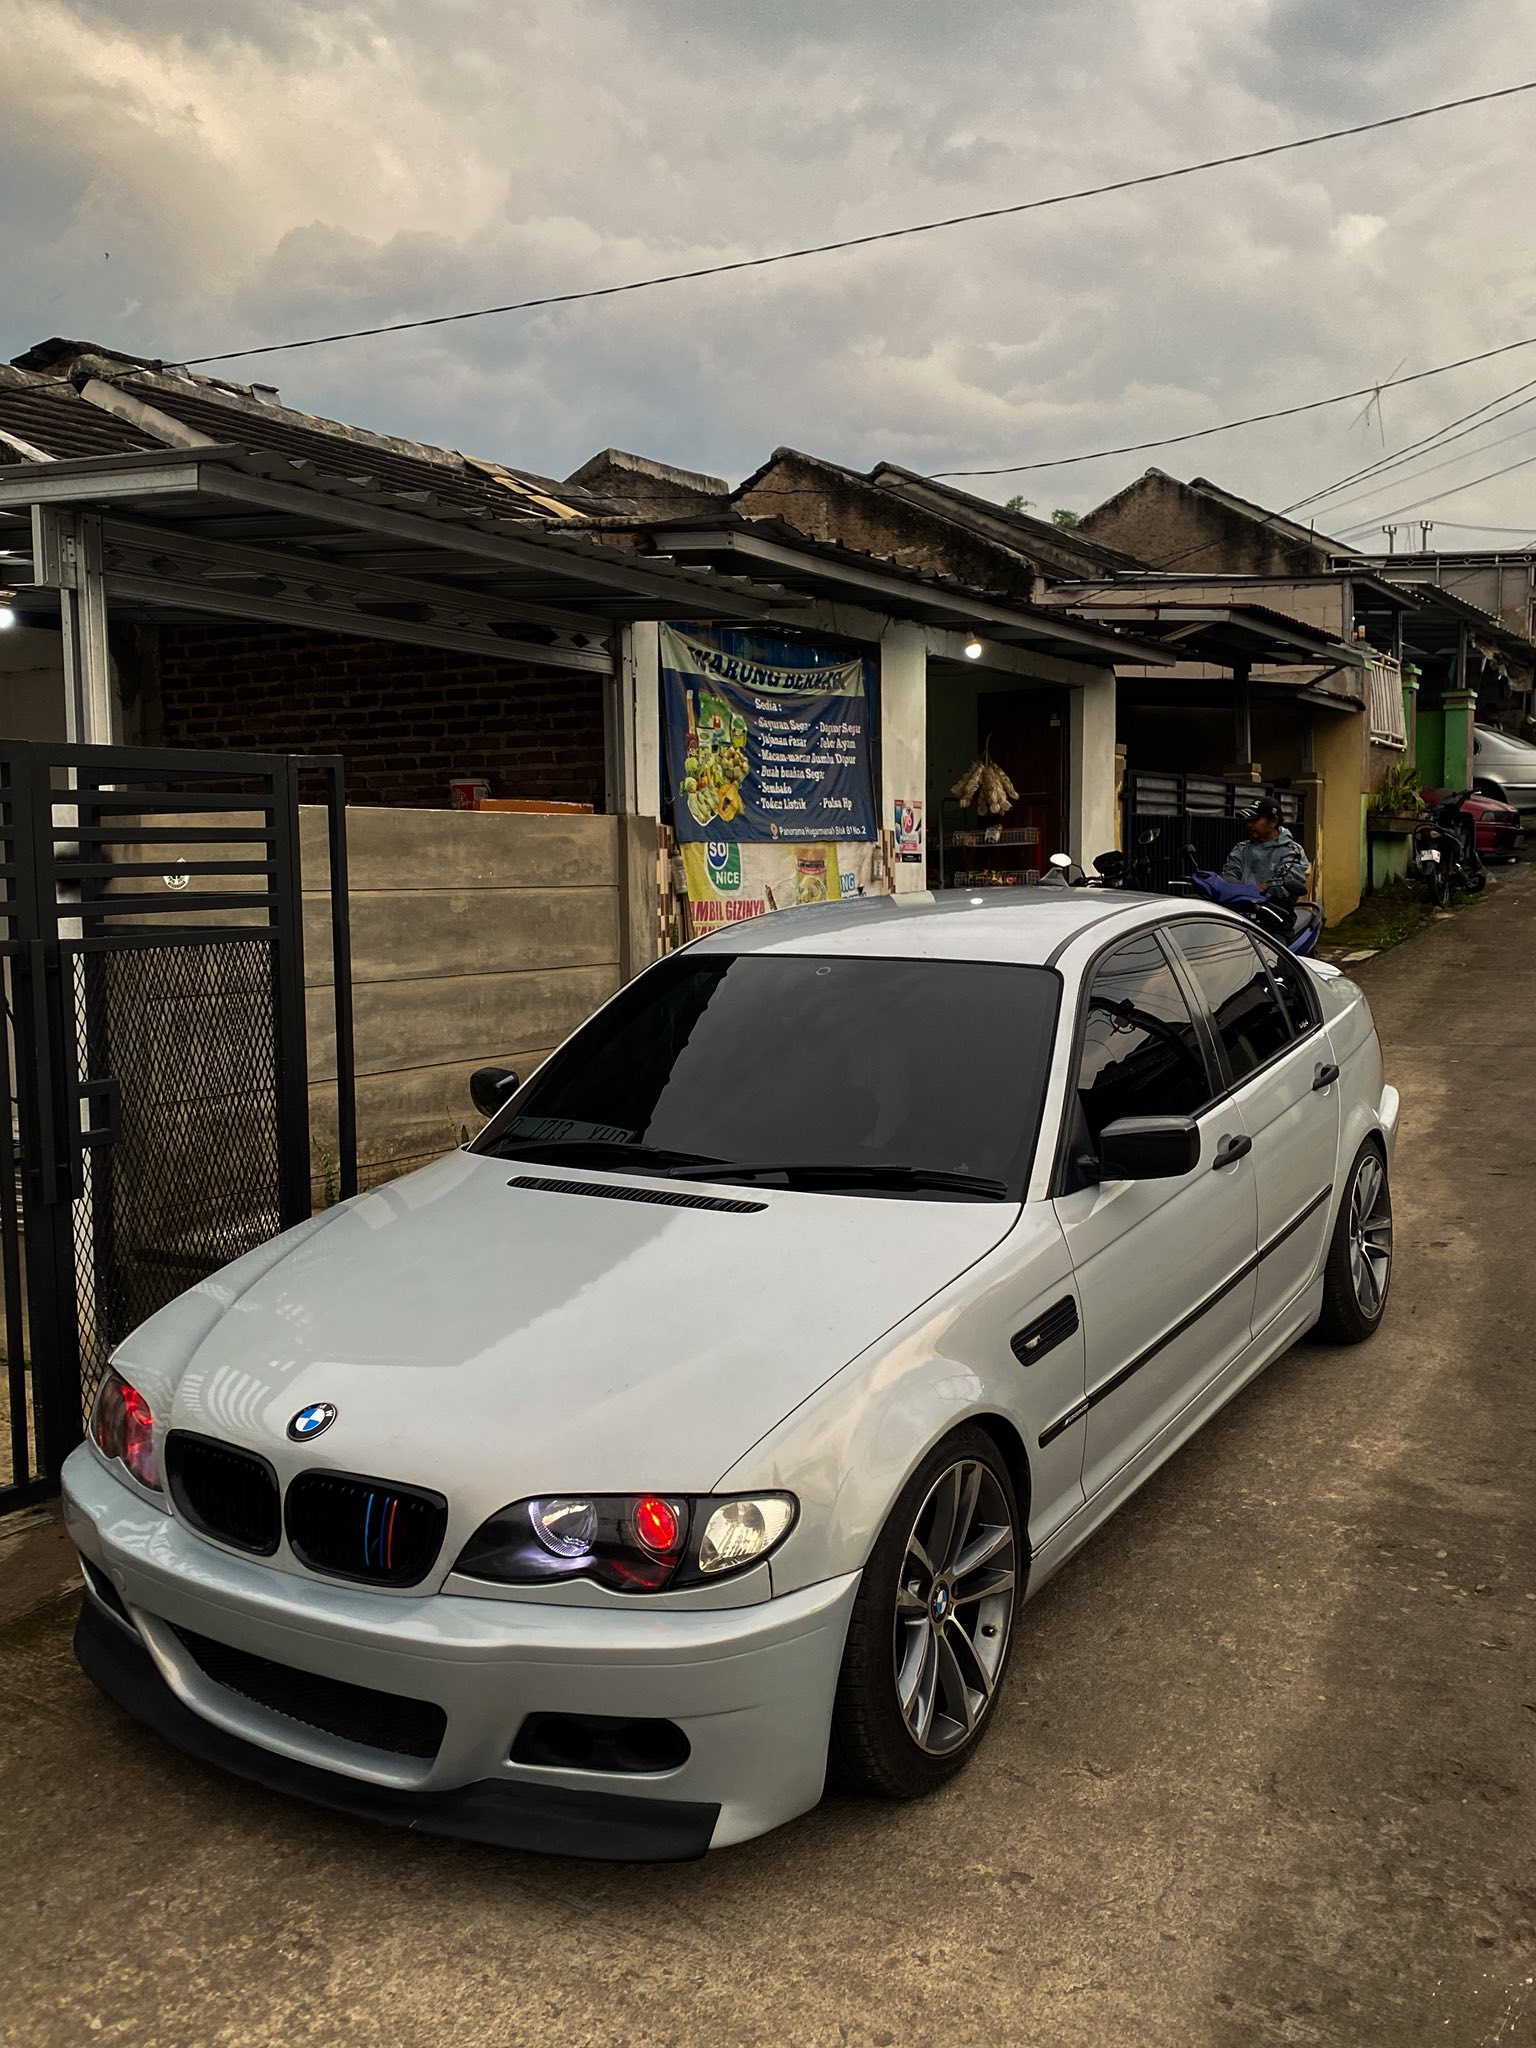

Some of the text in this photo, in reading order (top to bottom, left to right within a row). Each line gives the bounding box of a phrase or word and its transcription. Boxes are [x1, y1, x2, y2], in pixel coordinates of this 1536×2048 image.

[687, 646, 782, 687] WARUNG
[758, 716, 811, 733] Sayuran Segar
[841, 722, 861, 736] Segar
[760, 732, 807, 748] Jajanan Pasar
[836, 738, 856, 751] Ayam
[835, 753, 857, 767] Dapur
[761, 765, 779, 778] Buah
[805, 768, 826, 782] Segar
[761, 782, 792, 794] Sembako
[760, 797, 807, 810] Token Listrik
[823, 796, 842, 809] Pulsa
[779, 826, 805, 836] Panorama
[708, 842, 727, 857] SO
[715, 871, 740, 885] NICE
